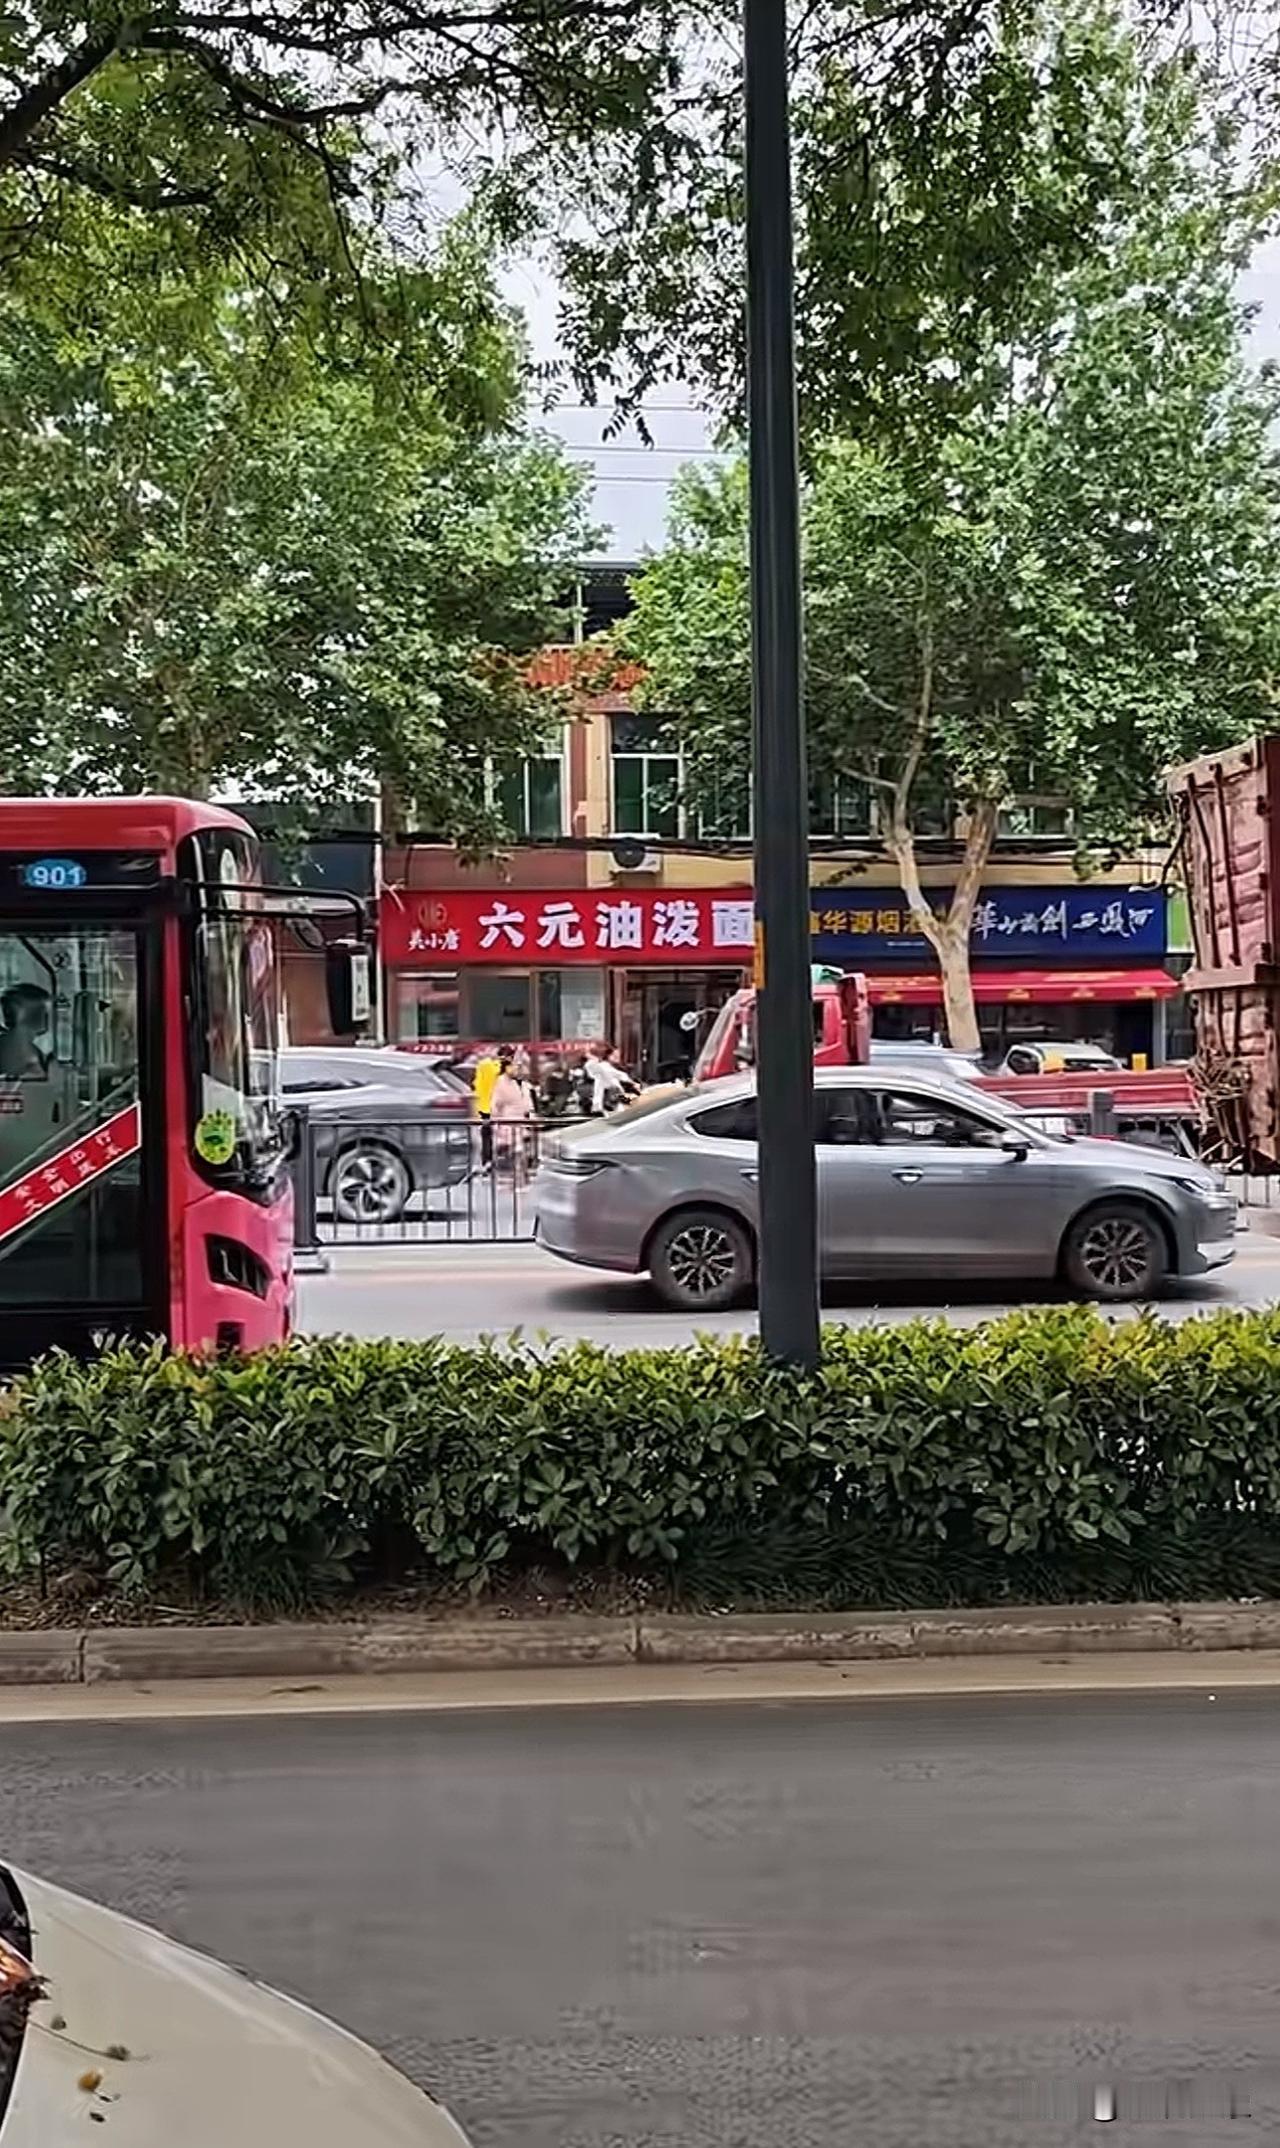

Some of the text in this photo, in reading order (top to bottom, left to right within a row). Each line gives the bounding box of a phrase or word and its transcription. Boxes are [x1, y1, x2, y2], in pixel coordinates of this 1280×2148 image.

[33, 866, 81, 885] 901
[478, 901, 755, 948] 六元油泼面
